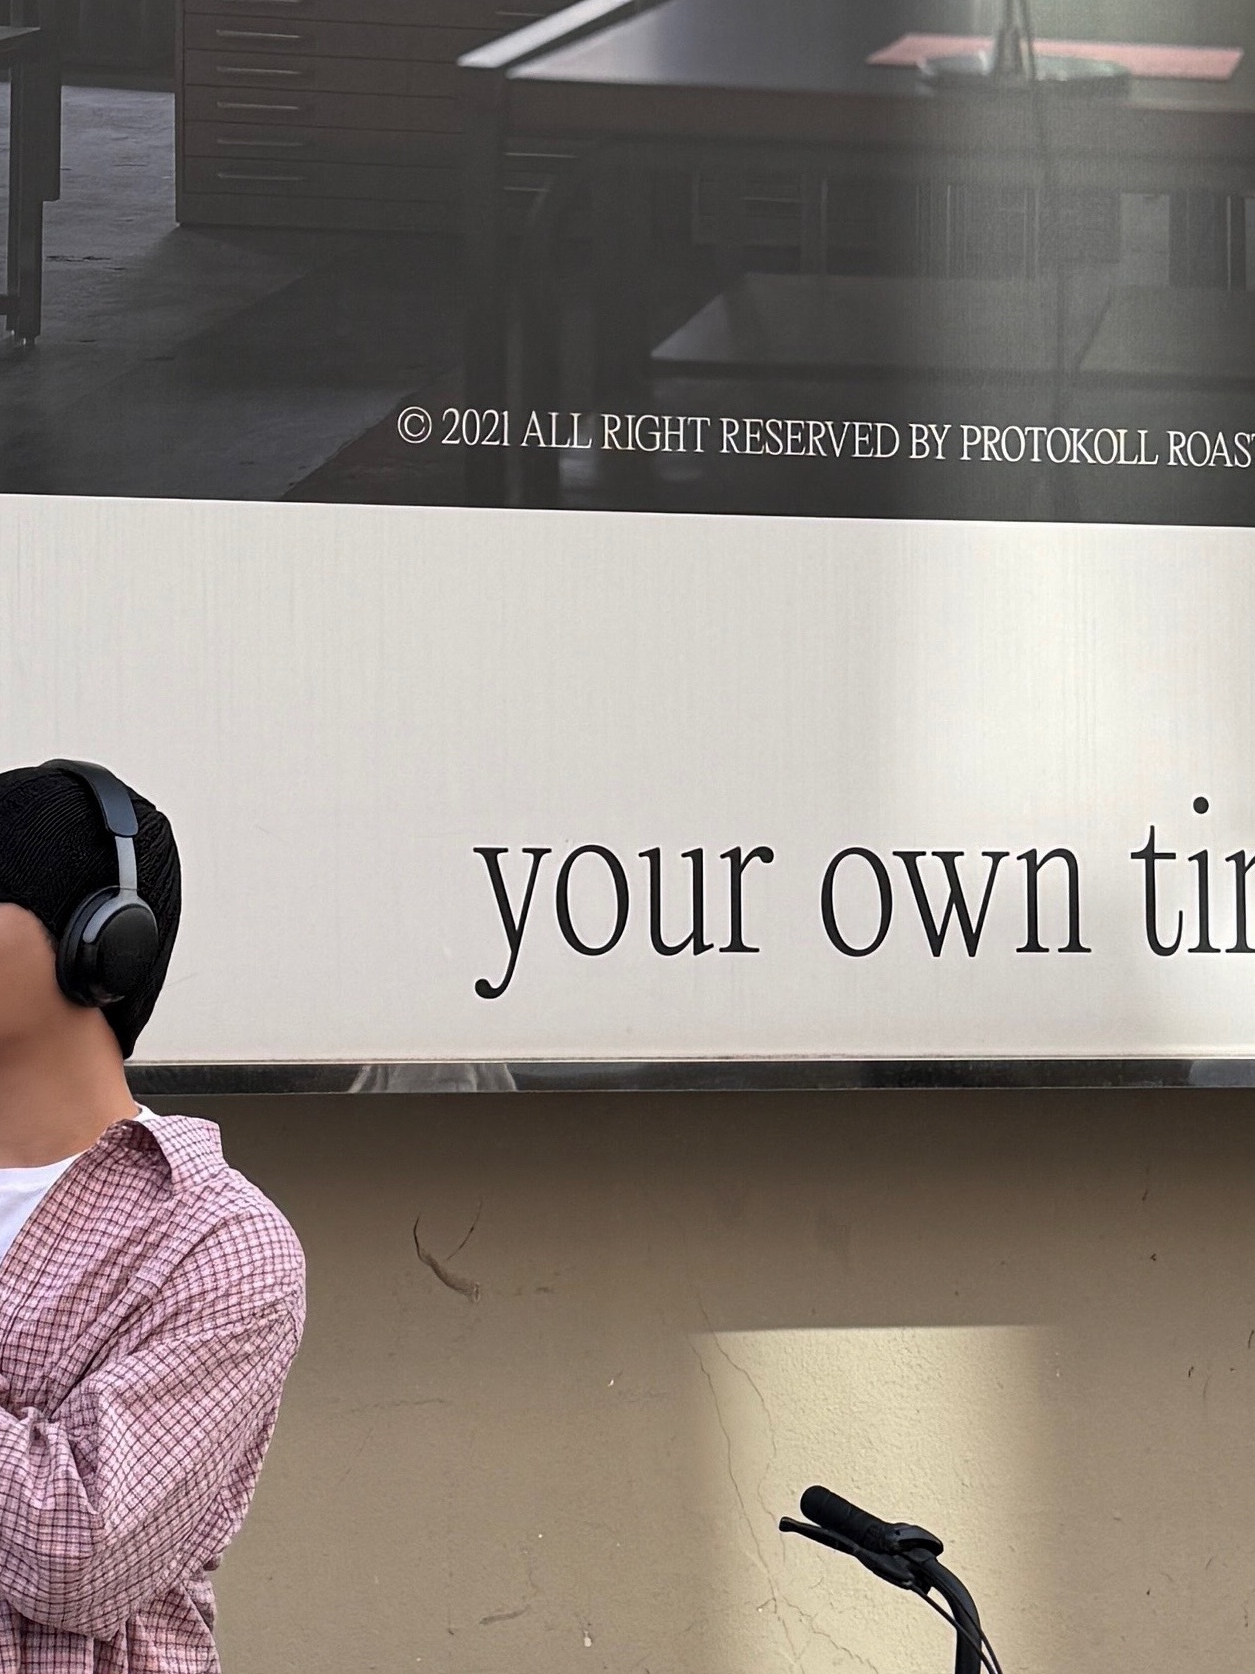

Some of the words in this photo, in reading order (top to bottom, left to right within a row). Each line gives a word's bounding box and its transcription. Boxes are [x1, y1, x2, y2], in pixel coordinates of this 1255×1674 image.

[441, 407, 510, 446] 2021
[520, 410, 593, 449] ALL
[601, 413, 711, 453] RIGHT
[719, 417, 900, 458] RESERVED
[908, 423, 952, 460] BY
[959, 424, 1159, 465] PROTOKOLL
[1166, 430, 1255, 468] ROAS
[472, 844, 775, 1000] your
[820, 846, 1092, 958] own
